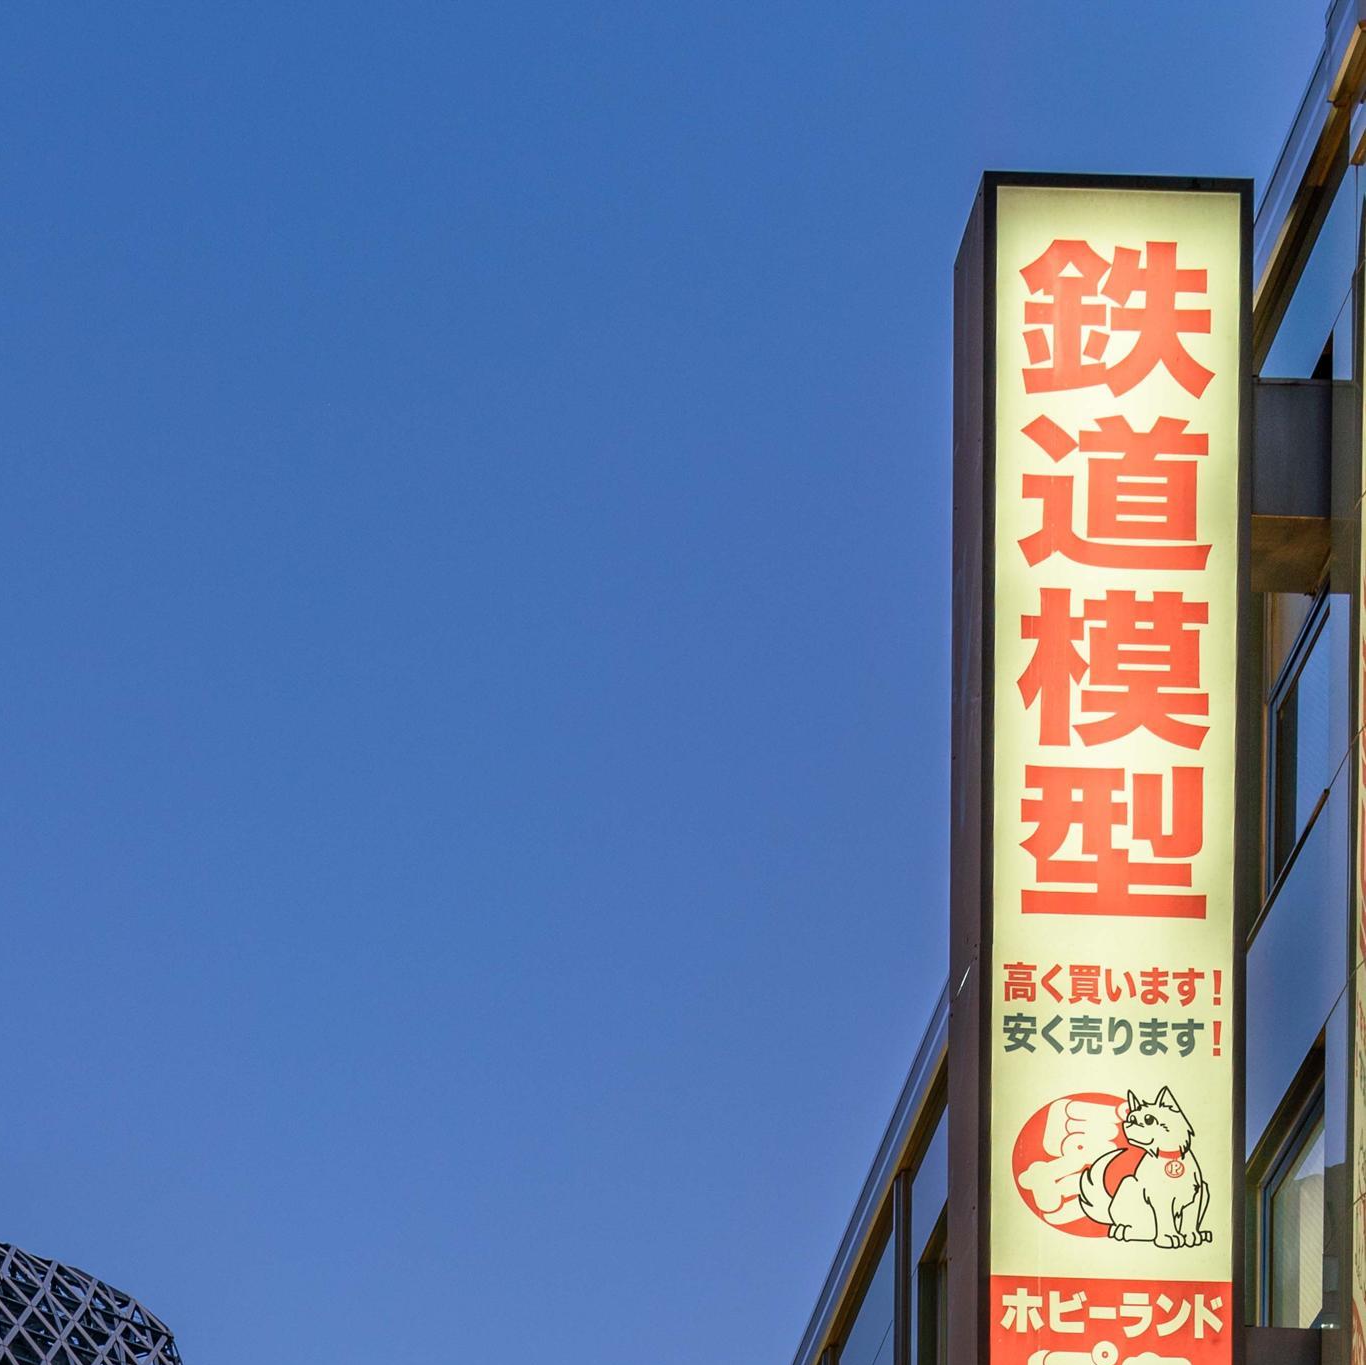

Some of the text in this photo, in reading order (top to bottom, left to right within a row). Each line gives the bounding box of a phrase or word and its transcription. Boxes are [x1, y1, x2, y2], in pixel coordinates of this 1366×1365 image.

[1017, 239, 1216, 919] 鉄道模型
[1002, 962, 1223, 1007] 高く買います!
[1002, 1014, 1223, 1057] 安く売ります!
[1001, 1292, 1224, 1339] ホビーランド
